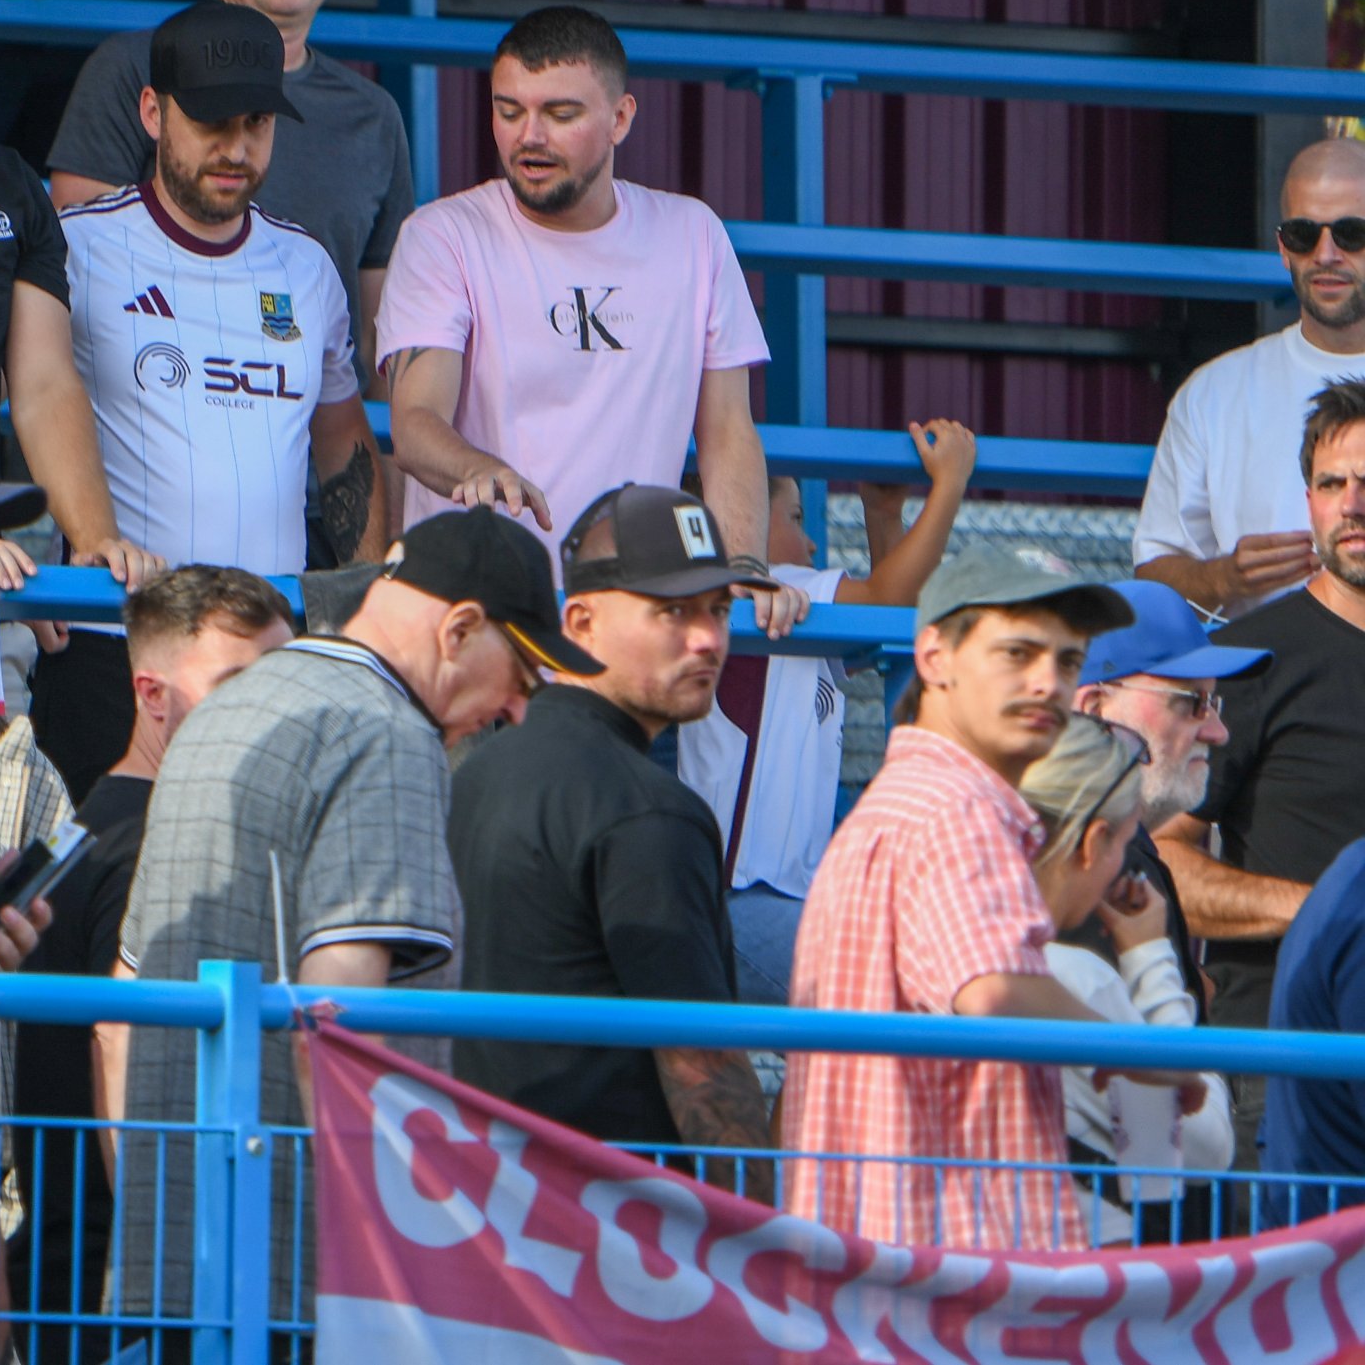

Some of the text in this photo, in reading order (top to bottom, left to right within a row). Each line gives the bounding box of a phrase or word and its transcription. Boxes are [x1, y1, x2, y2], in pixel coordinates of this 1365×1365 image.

[203, 357, 305, 401] SCL
[205, 395, 256, 411] COLLEGE
[369, 1072, 1365, 1365] CLOCKEND
